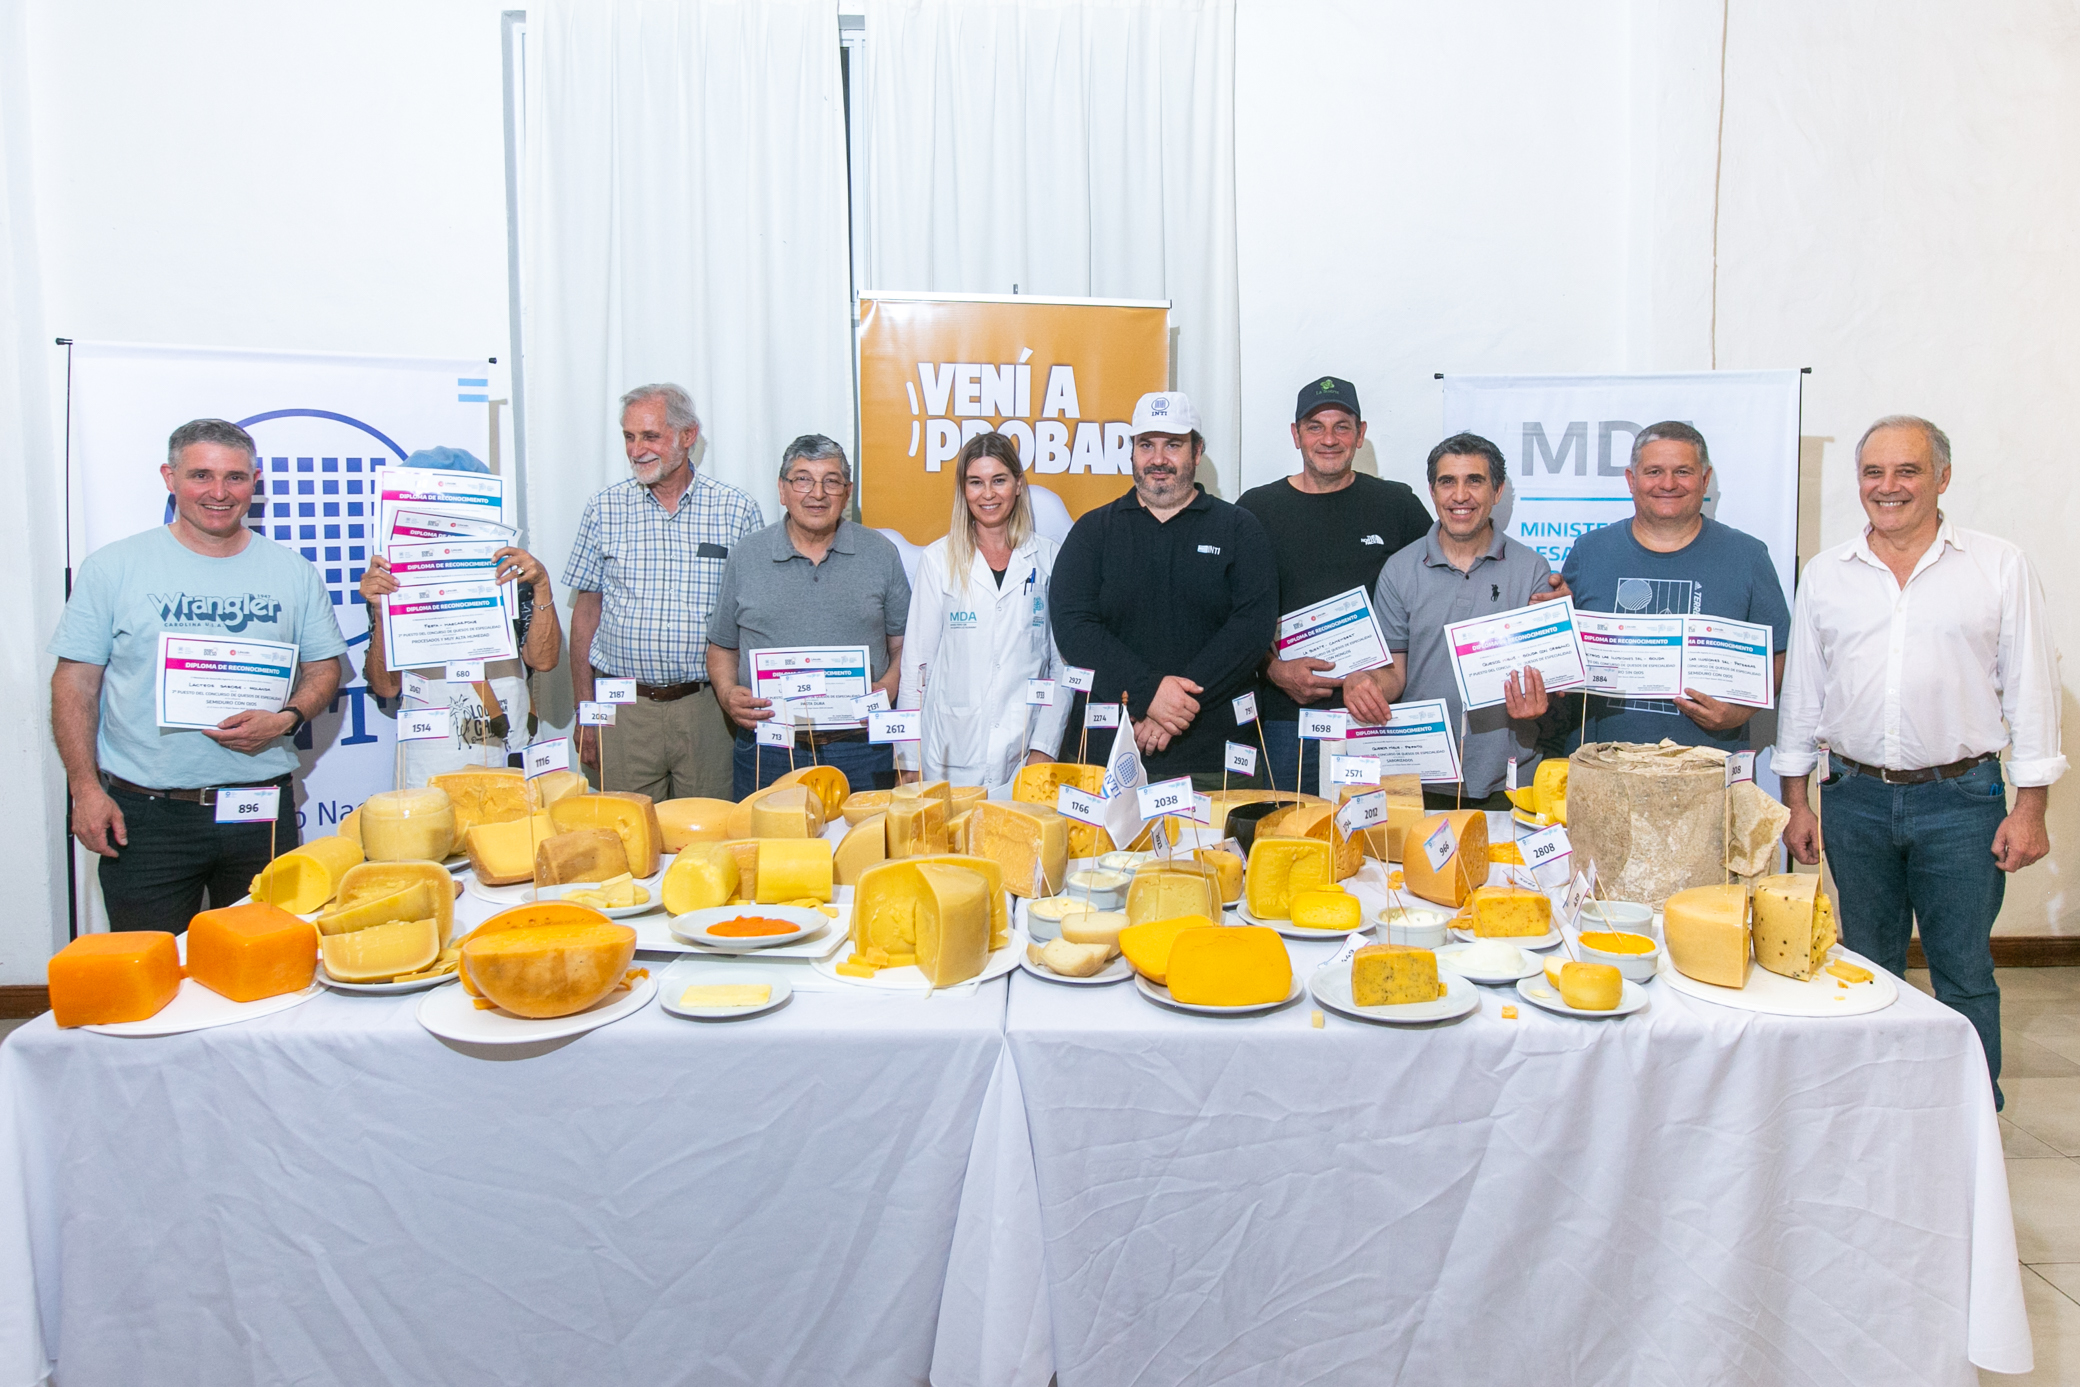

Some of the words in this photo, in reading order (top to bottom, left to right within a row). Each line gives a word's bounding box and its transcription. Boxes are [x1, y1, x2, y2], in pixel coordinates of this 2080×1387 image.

[917, 346, 1034, 418] VENÍ
[1042, 365, 1080, 418] A
[1522, 420, 1644, 476] MD
[437, 494, 488, 504] RECONOCIMIENTO
[410, 530, 438, 538] DIPLOMA
[440, 600, 490, 609] RECONOCIMIENTO
[147, 592, 282, 633] Wrangler
[950, 612, 977, 621] MDA
[1287, 633, 1308, 645] DIPLOMA
[1315, 614, 1358, 633] RECONOCIMIENTO
[1350, 634, 1372, 646] ESPECIALIDAD
[1584, 635, 1608, 643] DIPLOMA
[1706, 640, 1753, 652] RECONOCIMIENTO
[1334, 650, 1351, 658] HONGOS
[1545, 650, 1572, 661] ESPECIALIDAD
[228, 665, 280, 675] RECONOCIMIENTO
[1736, 668, 1761, 676] ESPECIALIDAD
[1069, 676, 1081, 684] 2927
[409, 684, 421, 694] 2067
[867, 703, 879, 711] 2131
[412, 724, 431, 732] 1514
[886, 724, 905, 734] 2612
[1312, 724, 1331, 733] 1698
[1234, 756, 1248, 766] 2920
[1345, 769, 1363, 777] 2571
[1154, 795, 1178, 809] 2038
[239, 803, 259, 813] 896
[1072, 801, 1089, 815] 1766
[1365, 807, 1378, 819] 2012
[1440, 841, 1450, 856] 966
[1533, 843, 1556, 858] 2808
